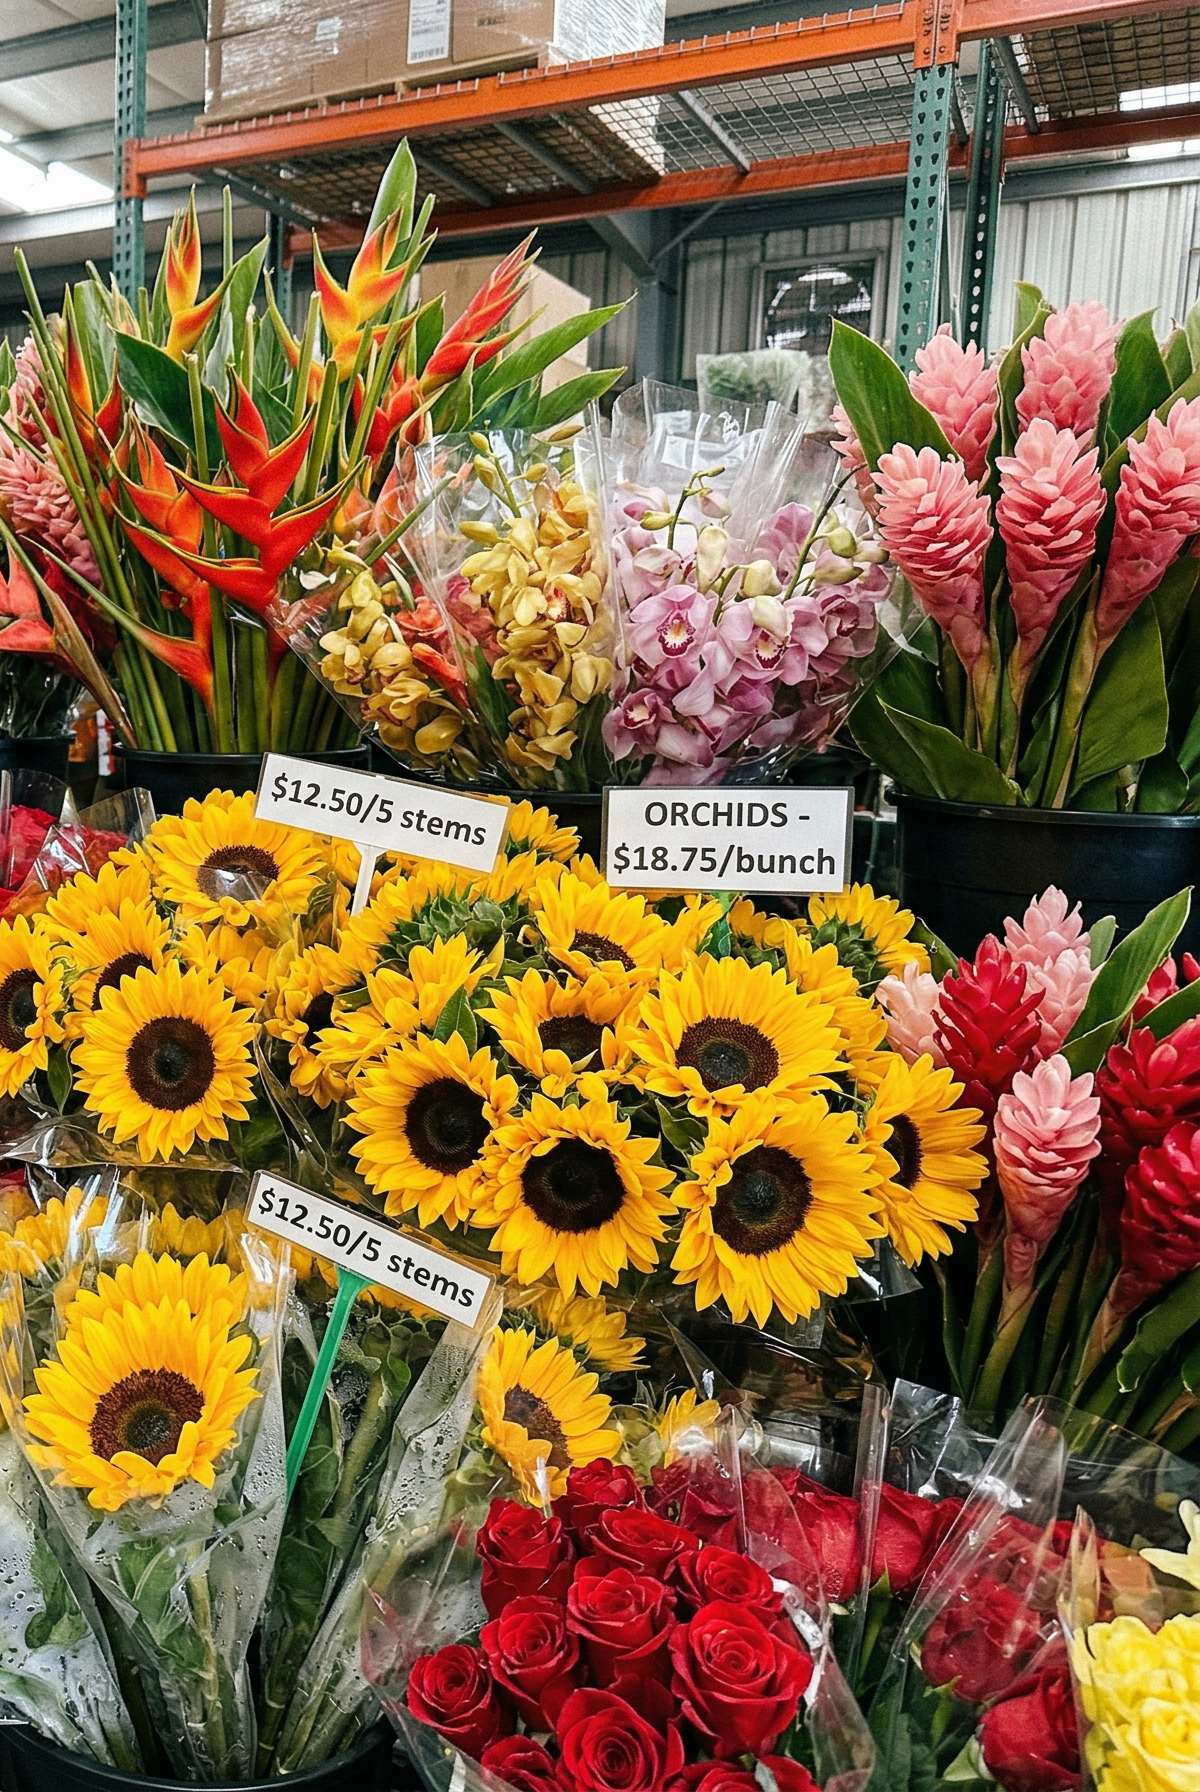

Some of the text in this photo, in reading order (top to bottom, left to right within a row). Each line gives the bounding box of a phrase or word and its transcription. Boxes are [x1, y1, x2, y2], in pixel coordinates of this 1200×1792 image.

[271, 772, 487, 846] $12.50/5 stems
[644, 801, 788, 828] ORCHIDS
[613, 842, 835, 878] $18.75/bunch
[258, 1187, 475, 1308] $12.50/5 stems
